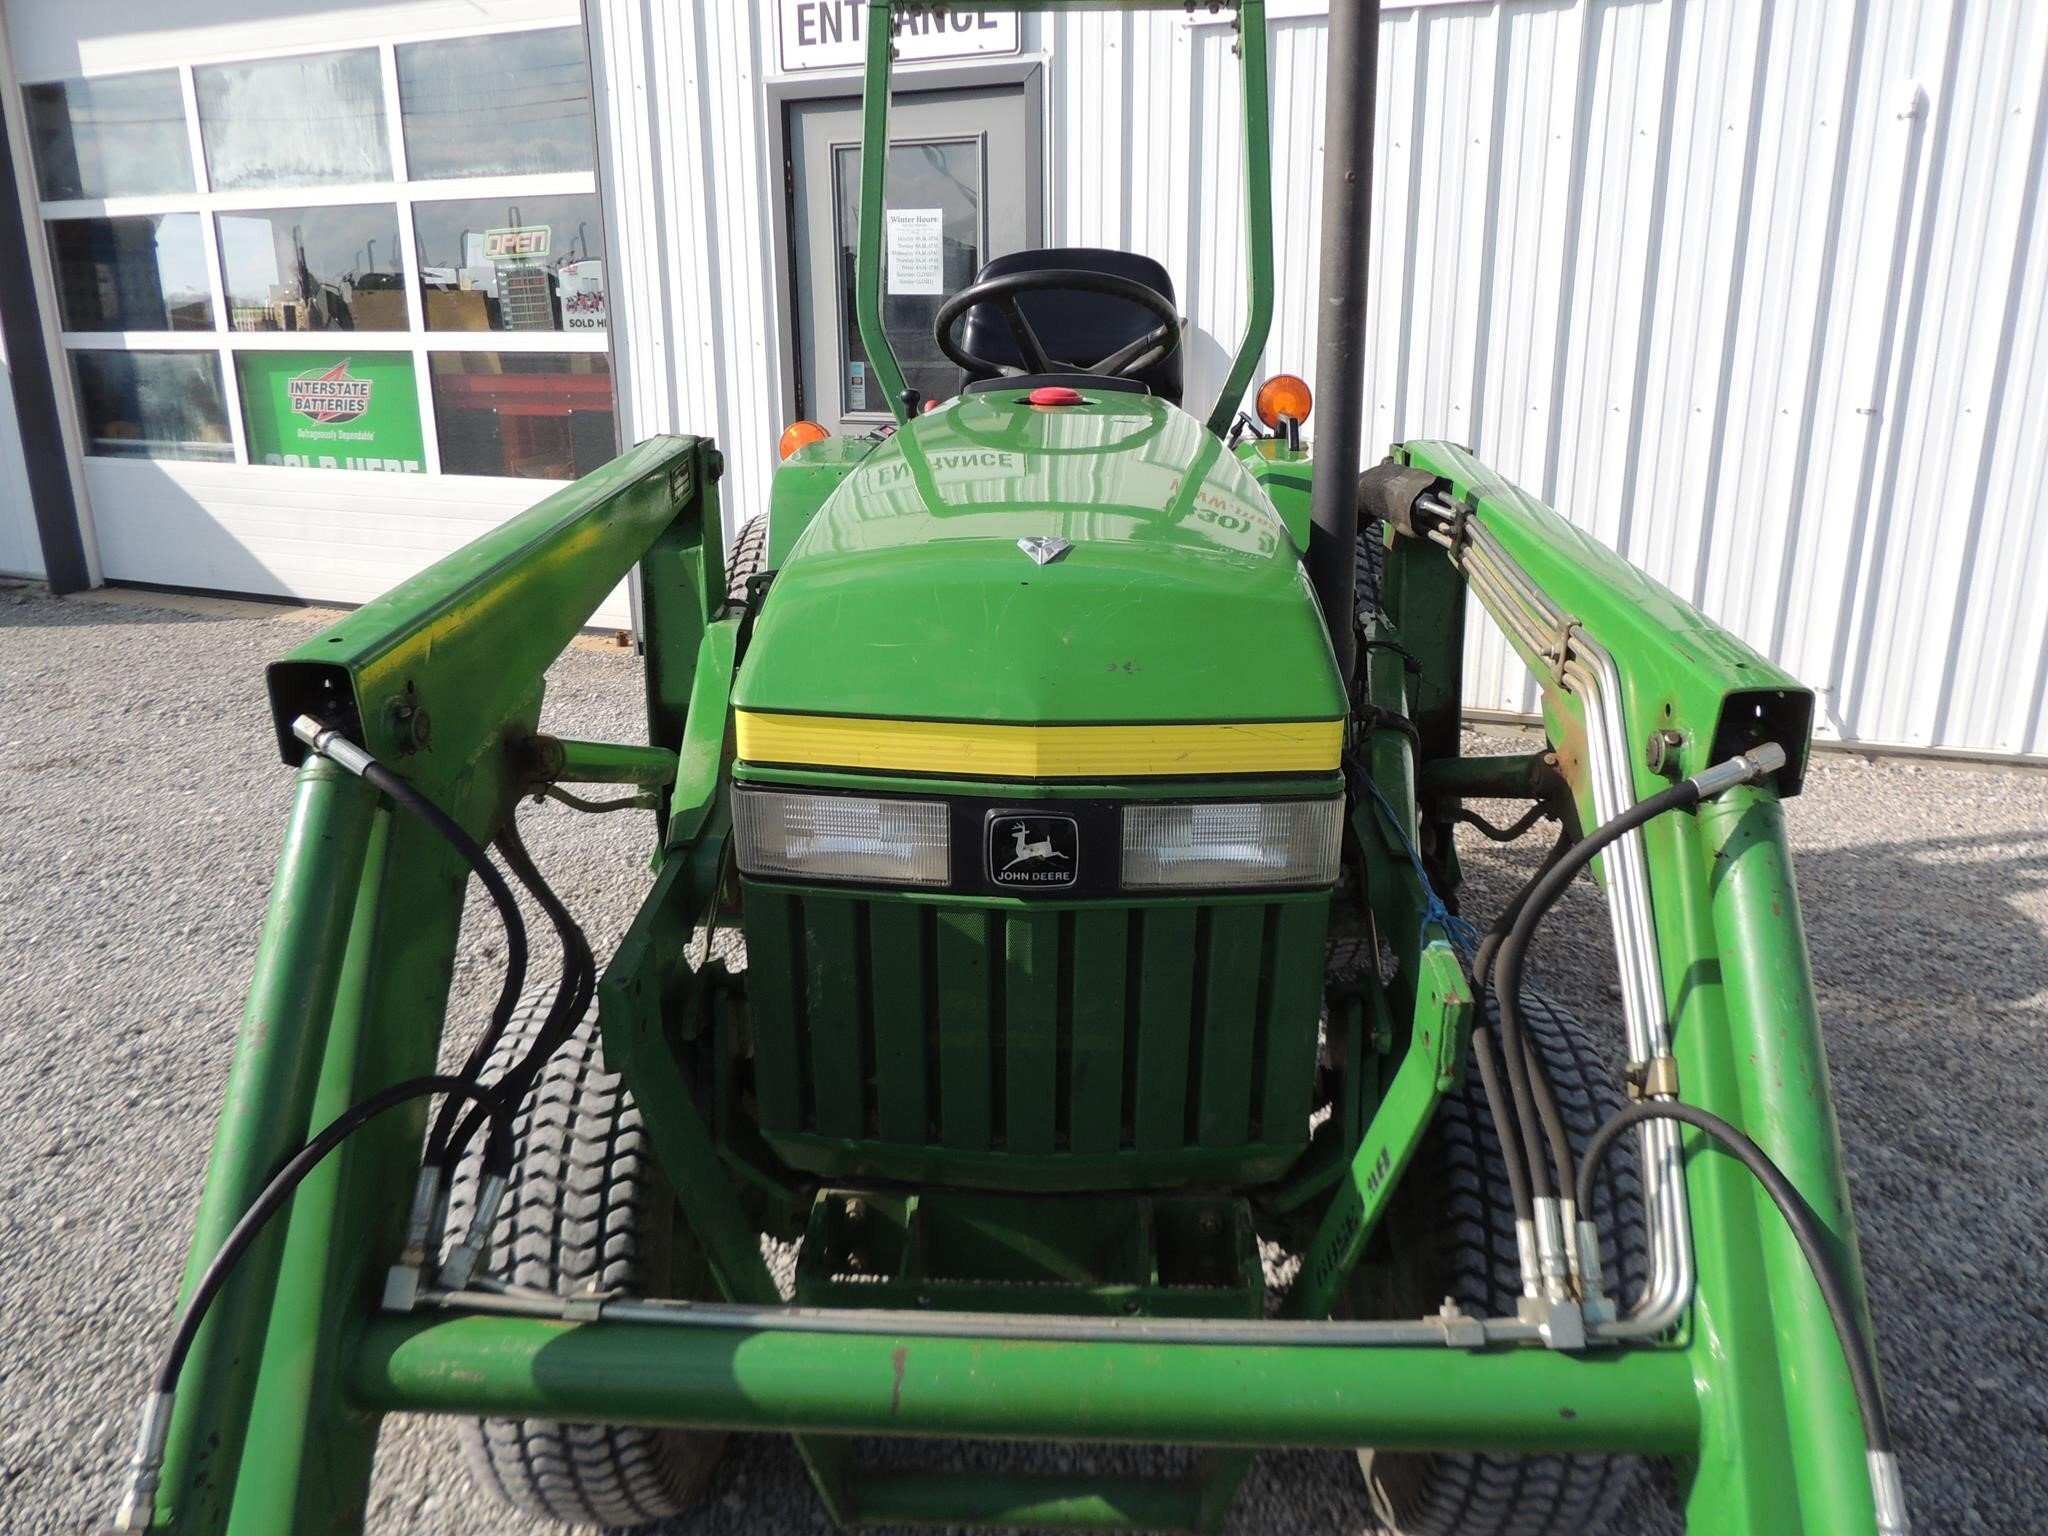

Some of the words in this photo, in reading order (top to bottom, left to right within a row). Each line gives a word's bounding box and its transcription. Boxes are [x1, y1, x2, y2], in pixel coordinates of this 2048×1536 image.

[797, 0, 998, 46] ENTAN
[891, 215, 914, 223] Winter
[488, 231, 546, 255] OPEN
[569, 319, 594, 328] SOLD
[290, 382, 369, 396] INTERSTATE
[294, 398, 365, 411] BATTERIES
[998, 872, 1029, 881] JOHN
[1032, 872, 1070, 881] DEERE
